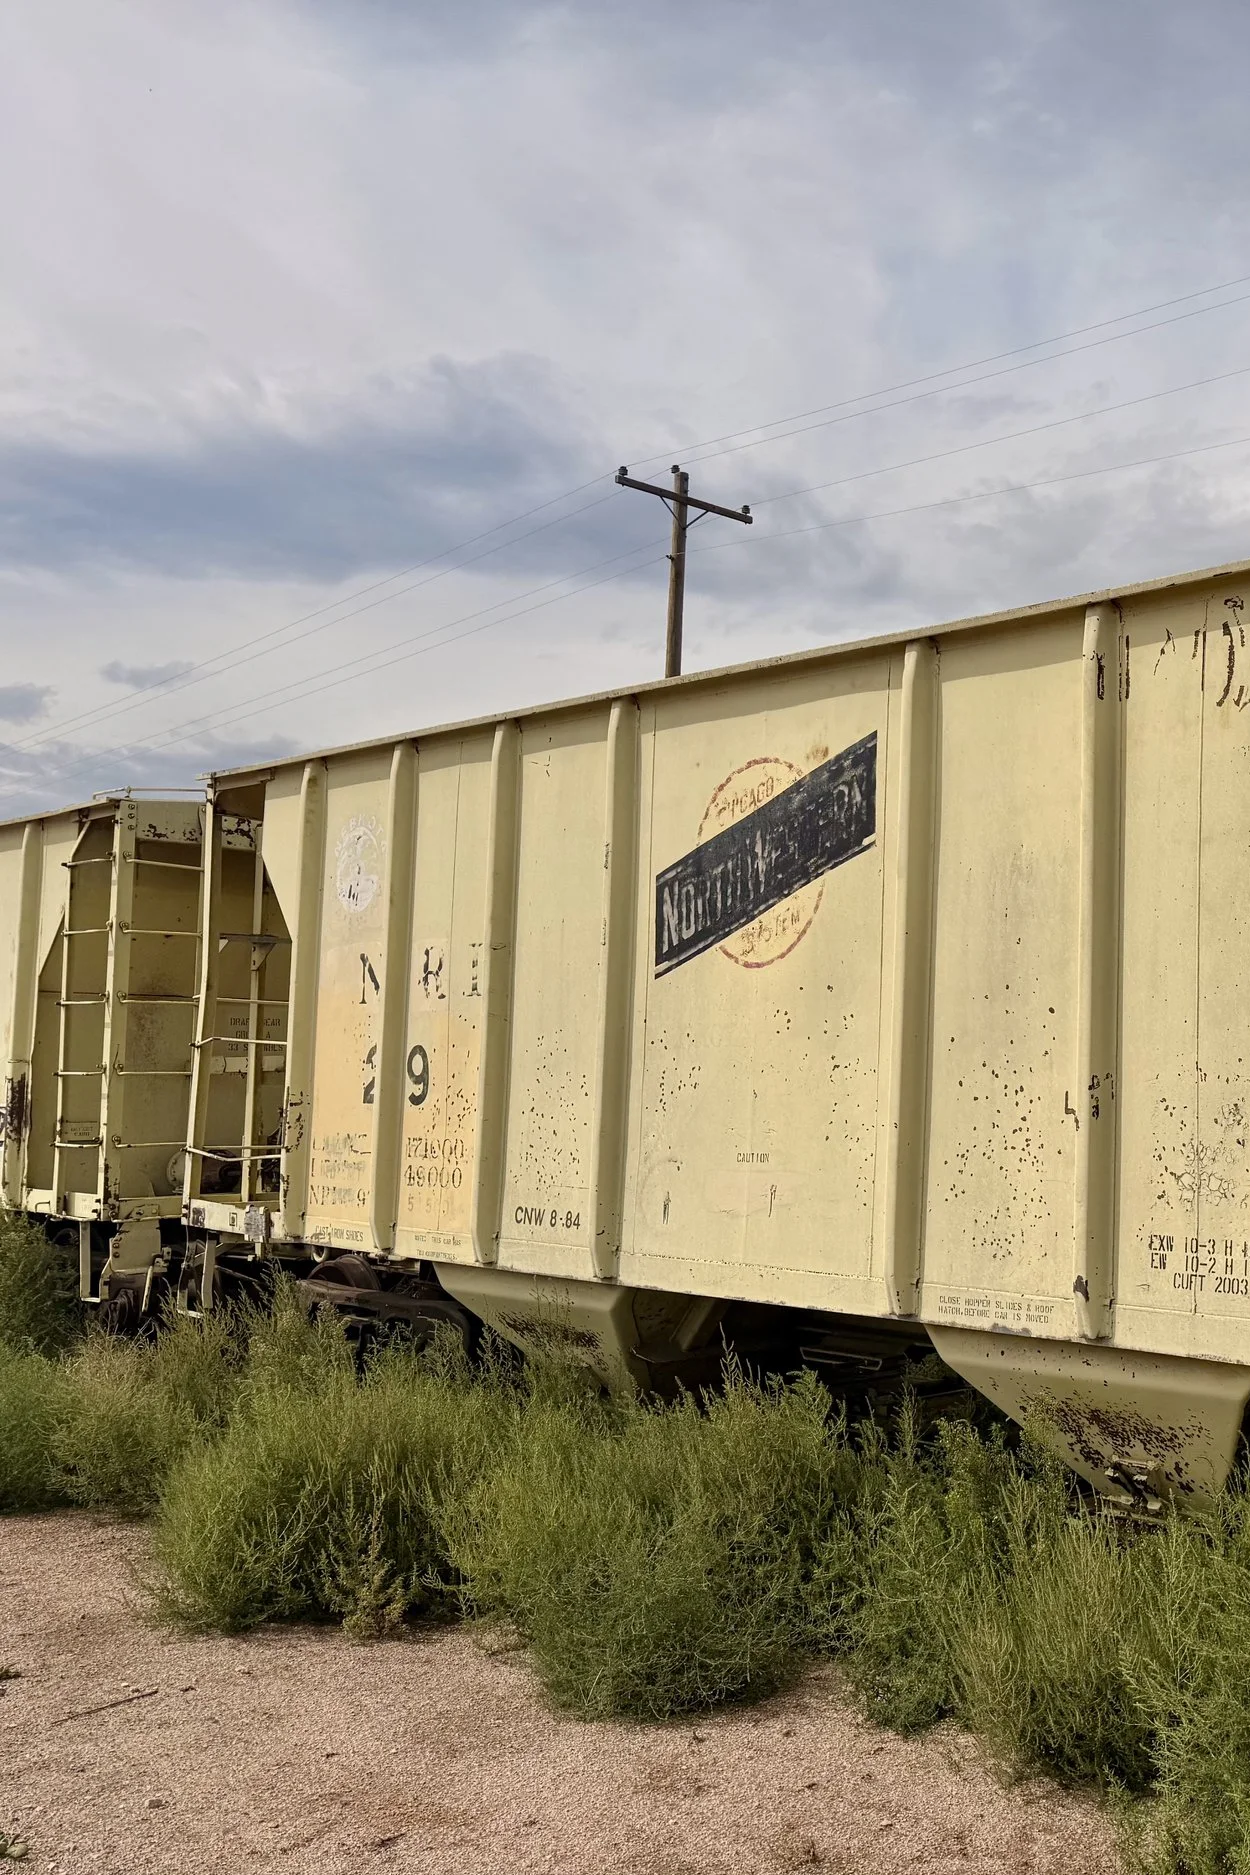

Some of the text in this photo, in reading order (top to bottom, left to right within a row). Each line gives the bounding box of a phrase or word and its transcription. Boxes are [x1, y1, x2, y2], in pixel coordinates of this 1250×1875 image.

[230, 1017, 249, 1027] DRAF
[736, 1152, 770, 1163] CAUTION
[514, 1206, 546, 1227] CNW
[346, 1229, 364, 1242] SHOES
[1149, 1234, 1174, 1252] EXW
[1184, 1236, 1216, 1255] 10-3
[1224, 1239, 1233, 1257] H
[1150, 1252, 1168, 1270] EW
[1185, 1255, 1217, 1274] 10-2
[1225, 1258, 1234, 1275] H
[1214, 1276, 1249, 1295] 2003
[939, 1295, 961, 1305] CLOSE
[964, 1298, 991, 1308] HOPPER
[995, 1300, 1023, 1311] SLIDES
[1034, 1305, 1055, 1315] ROOF
[994, 1311, 1008, 1321] CAR
[1012, 1312, 1022, 1321] IS
[1025, 1313, 1049, 1324] MOVED
